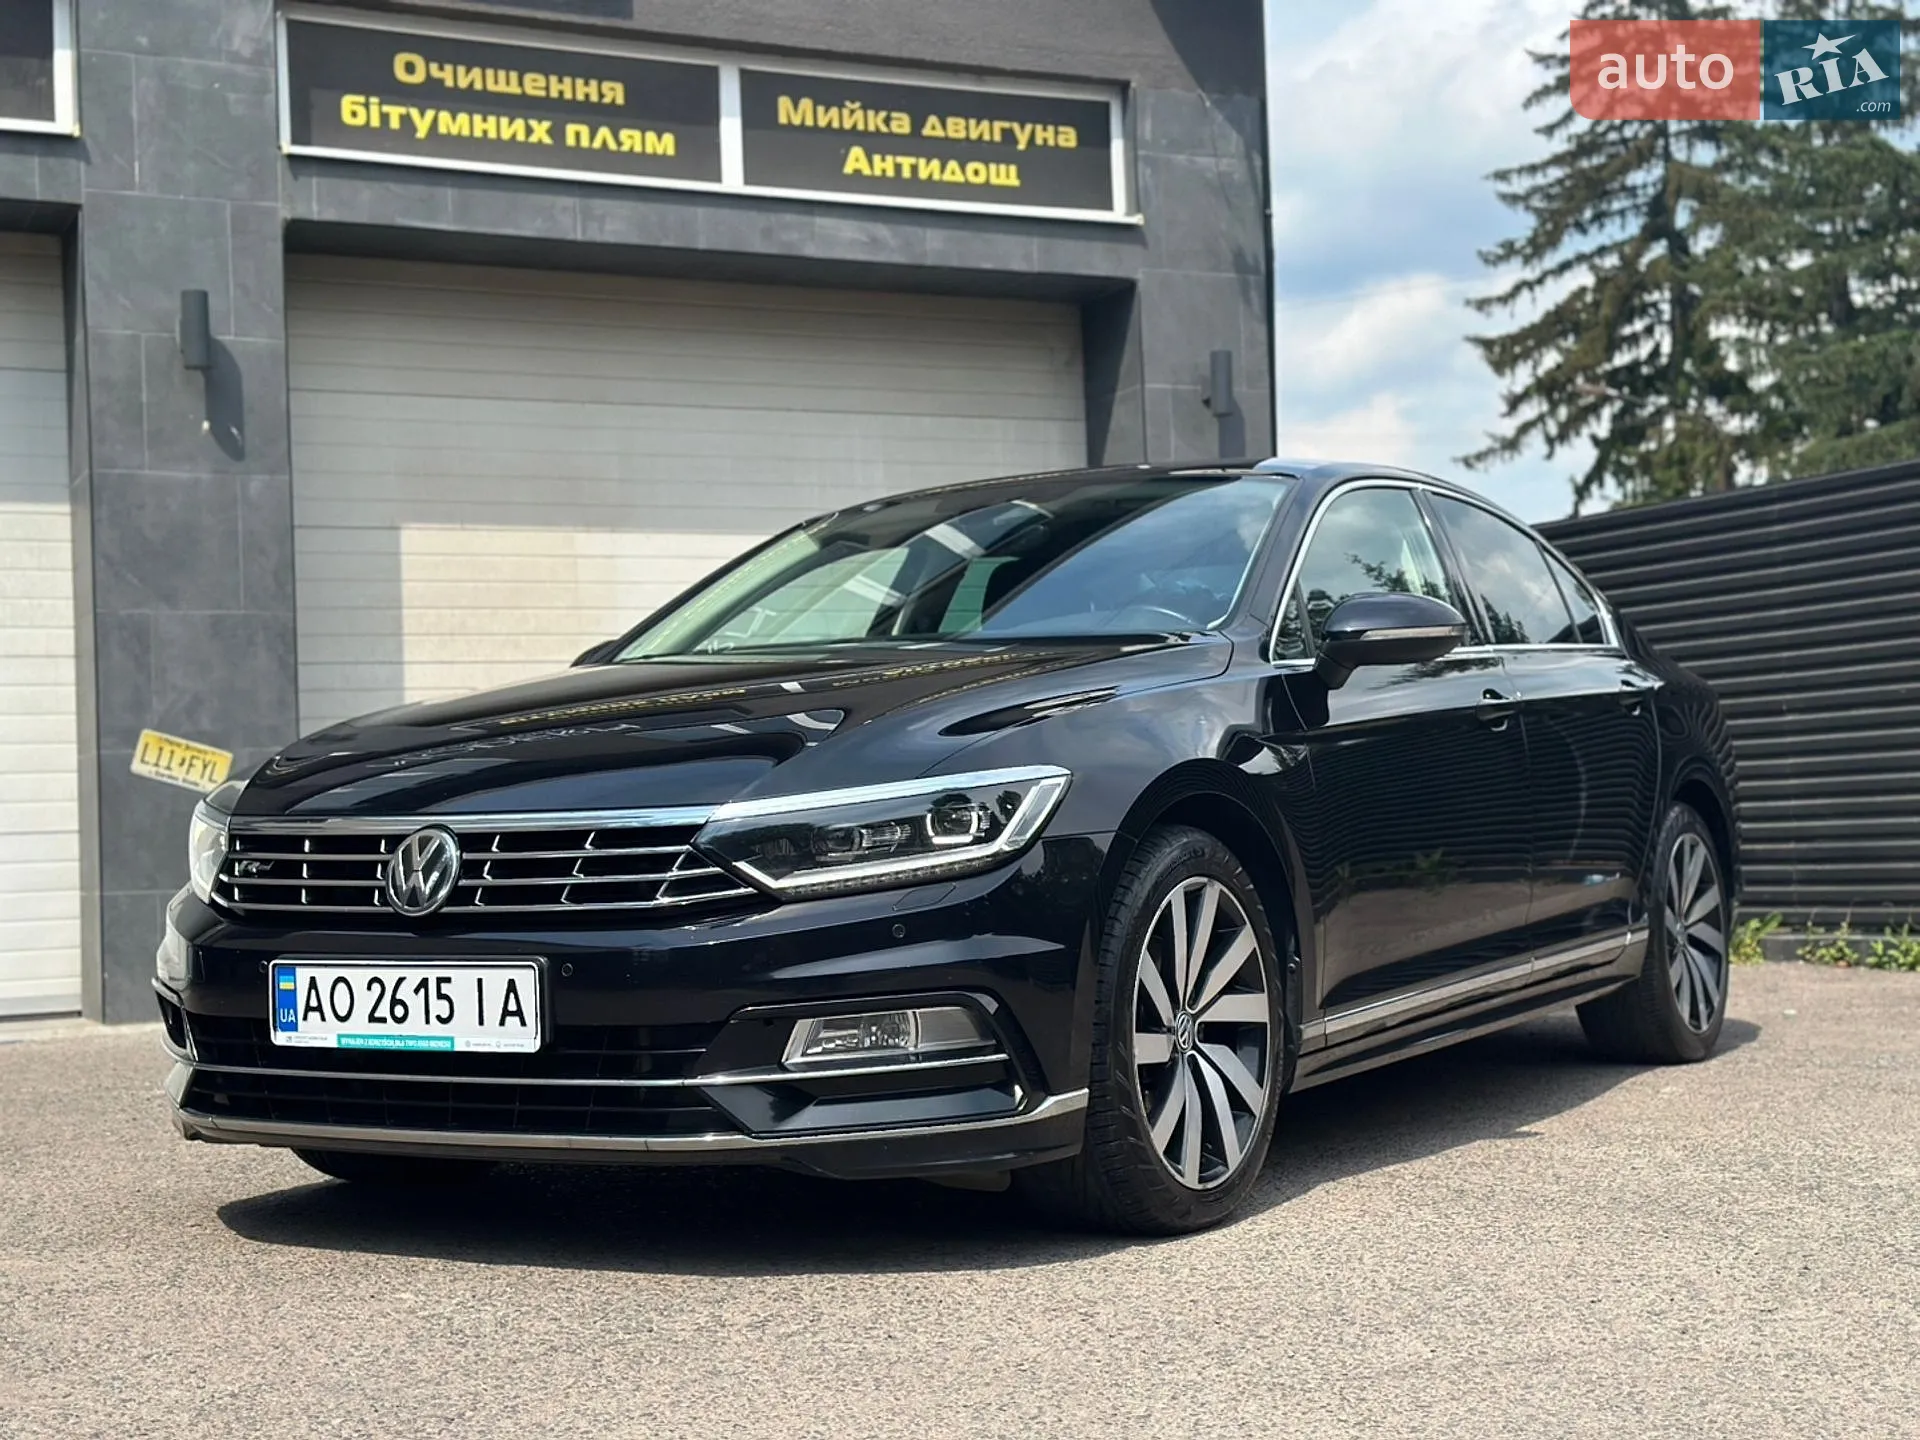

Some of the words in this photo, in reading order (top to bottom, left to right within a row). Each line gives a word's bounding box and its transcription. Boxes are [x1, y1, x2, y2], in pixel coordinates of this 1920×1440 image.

[392, 52, 626, 107] Очищення
[339, 94, 554, 146] бітумних
[564, 122, 678, 157] плям
[777, 95, 913, 136] Мийка
[922, 116, 1079, 150] двигуна
[842, 145, 1022, 188] Антидощ
[279, 1008, 296, 1024] UA
[302, 975, 355, 1023] AO
[365, 976, 455, 1025] 2615
[476, 977, 528, 1027] IA
